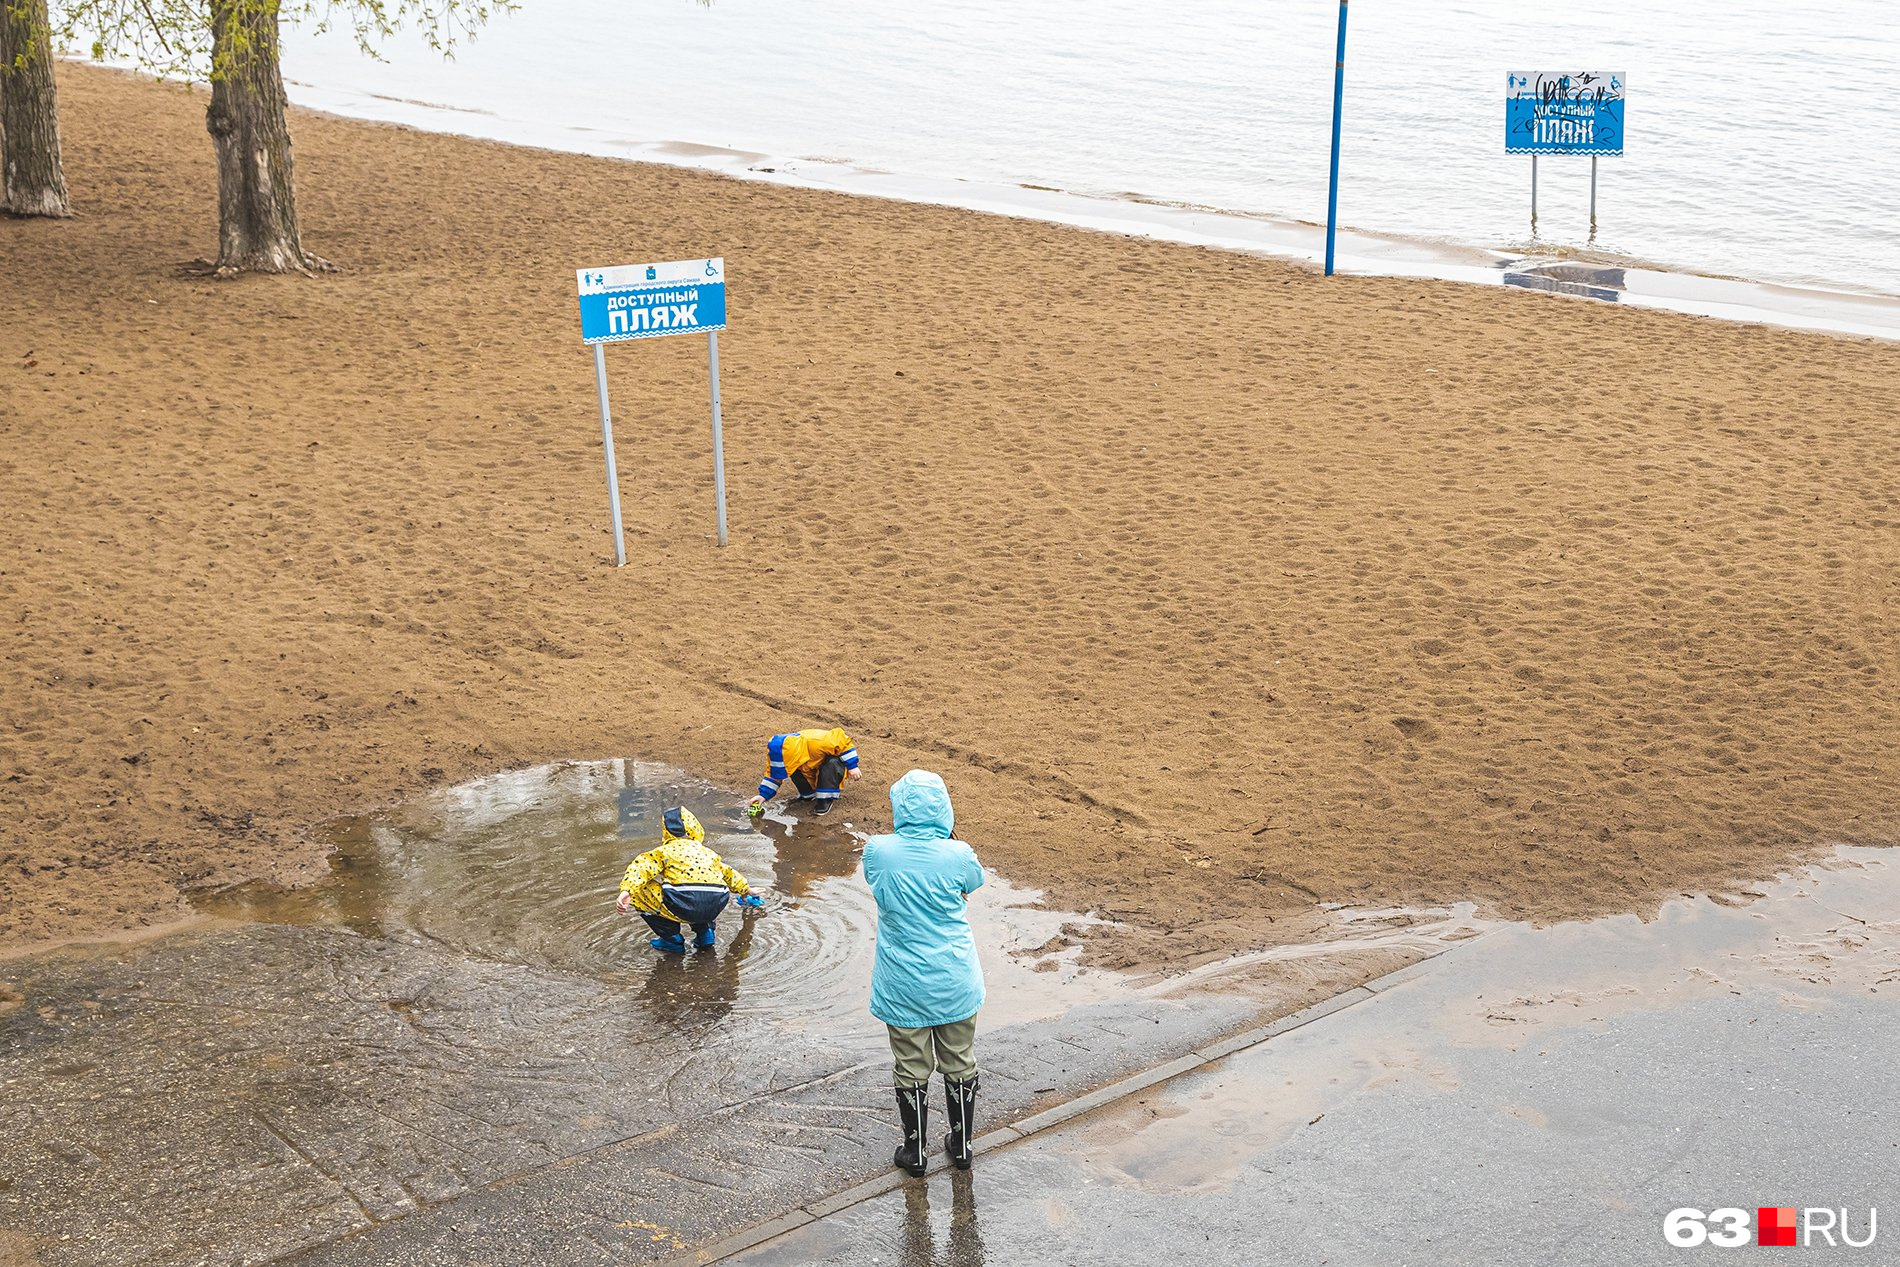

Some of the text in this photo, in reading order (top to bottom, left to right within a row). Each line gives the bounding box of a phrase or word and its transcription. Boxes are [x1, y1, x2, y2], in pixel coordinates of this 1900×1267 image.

[1533, 119, 1594, 144] ПЛЯЖ
[607, 288, 699, 311] ДОСТУПНЫЙ
[608, 303, 699, 334] ПЛЯЖ
